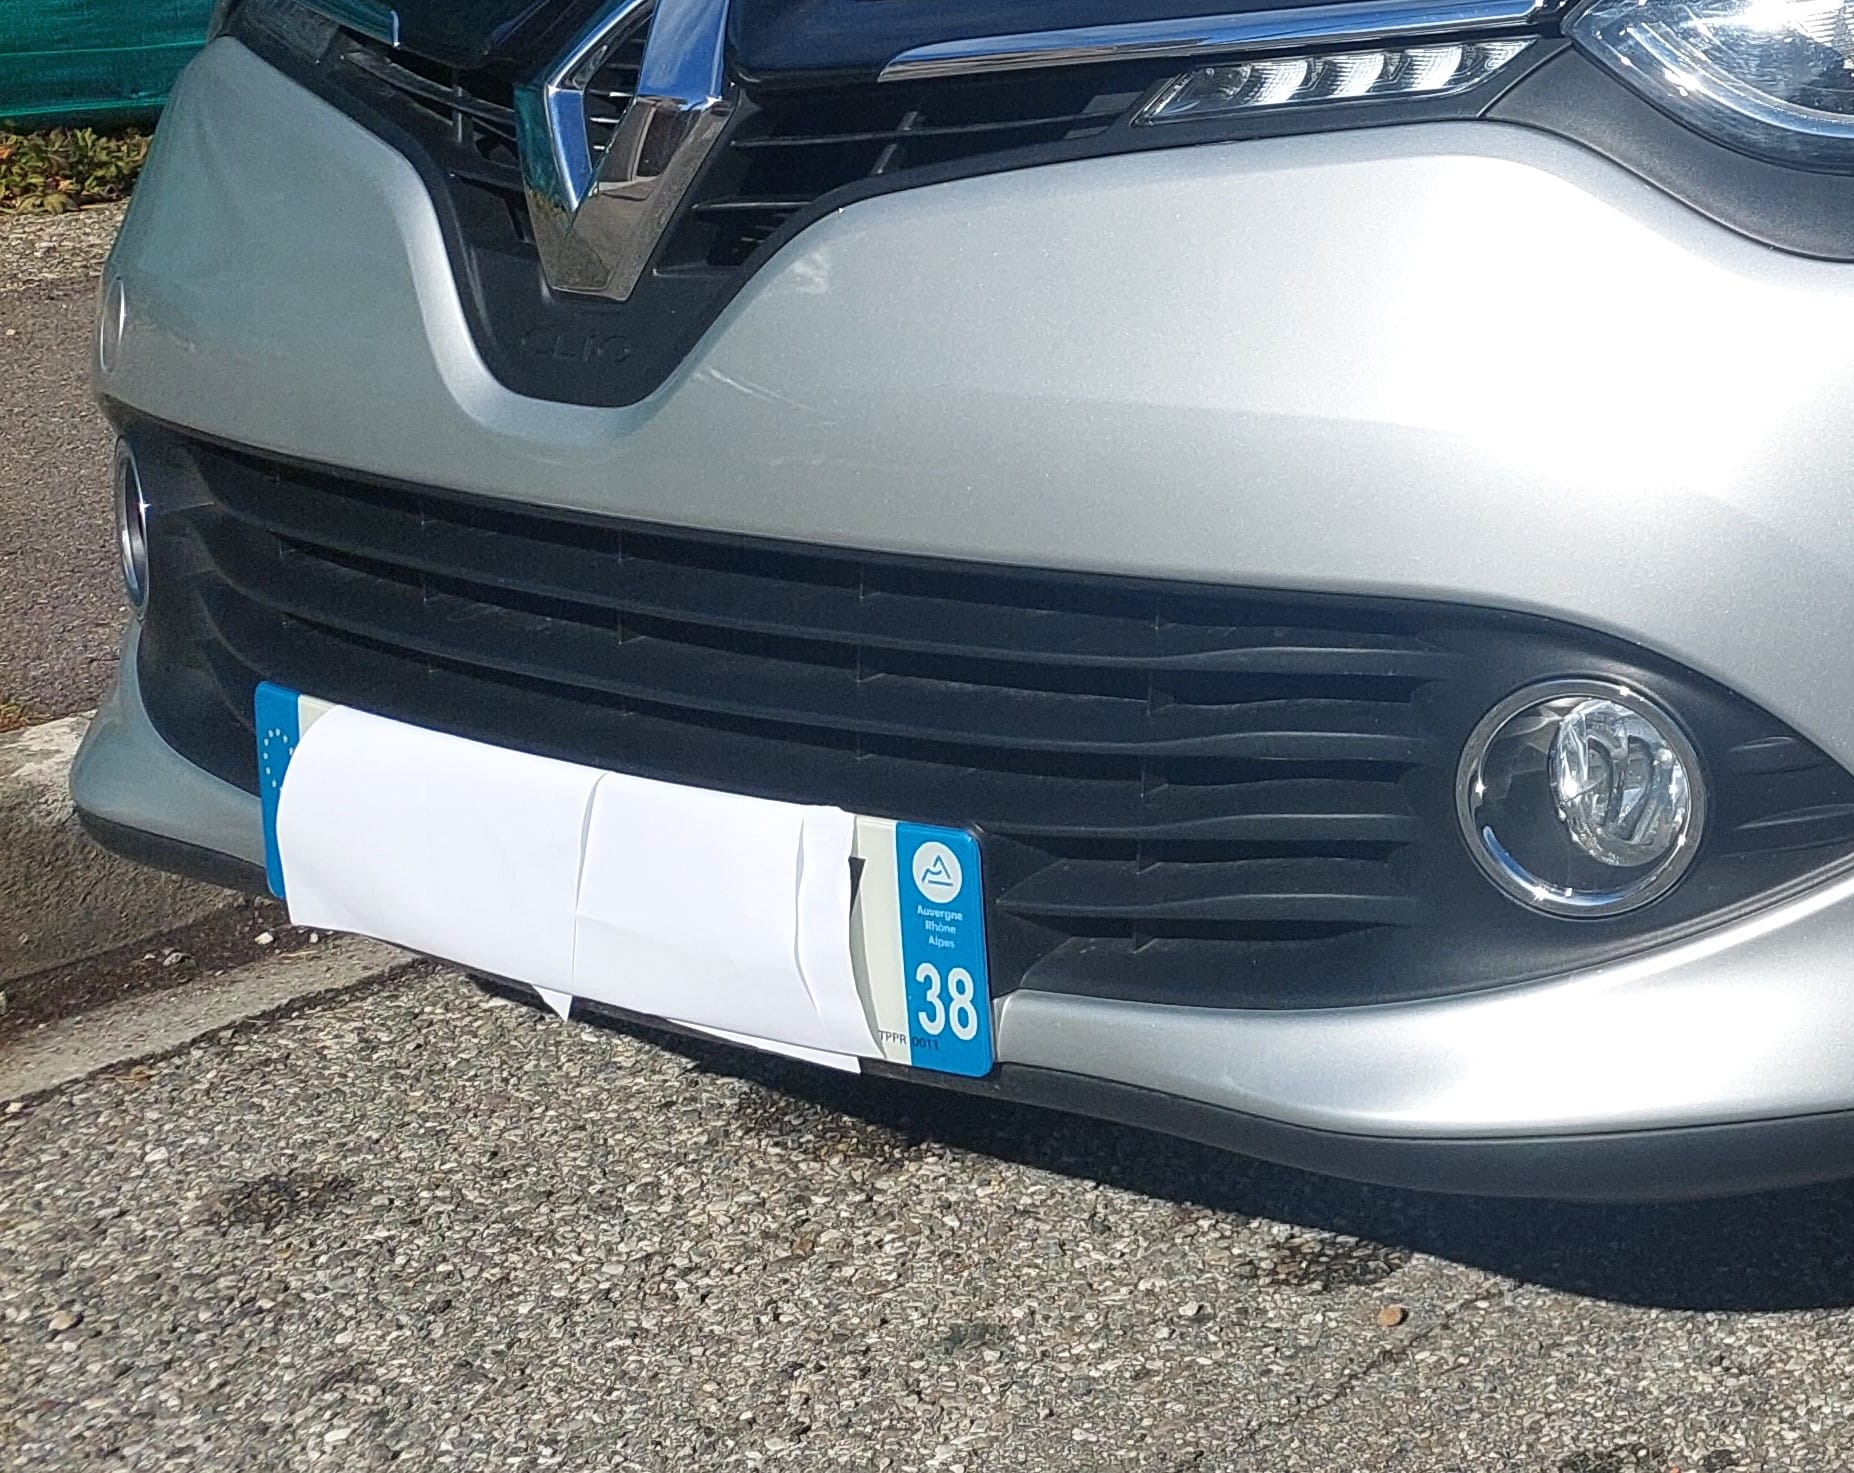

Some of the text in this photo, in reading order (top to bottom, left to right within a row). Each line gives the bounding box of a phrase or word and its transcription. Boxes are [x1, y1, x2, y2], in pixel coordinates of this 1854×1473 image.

[917, 904, 963, 922] Auvergne
[928, 935, 955, 949] Alpes
[915, 962, 978, 1041] 38
[878, 1029, 907, 1045] TPPR
